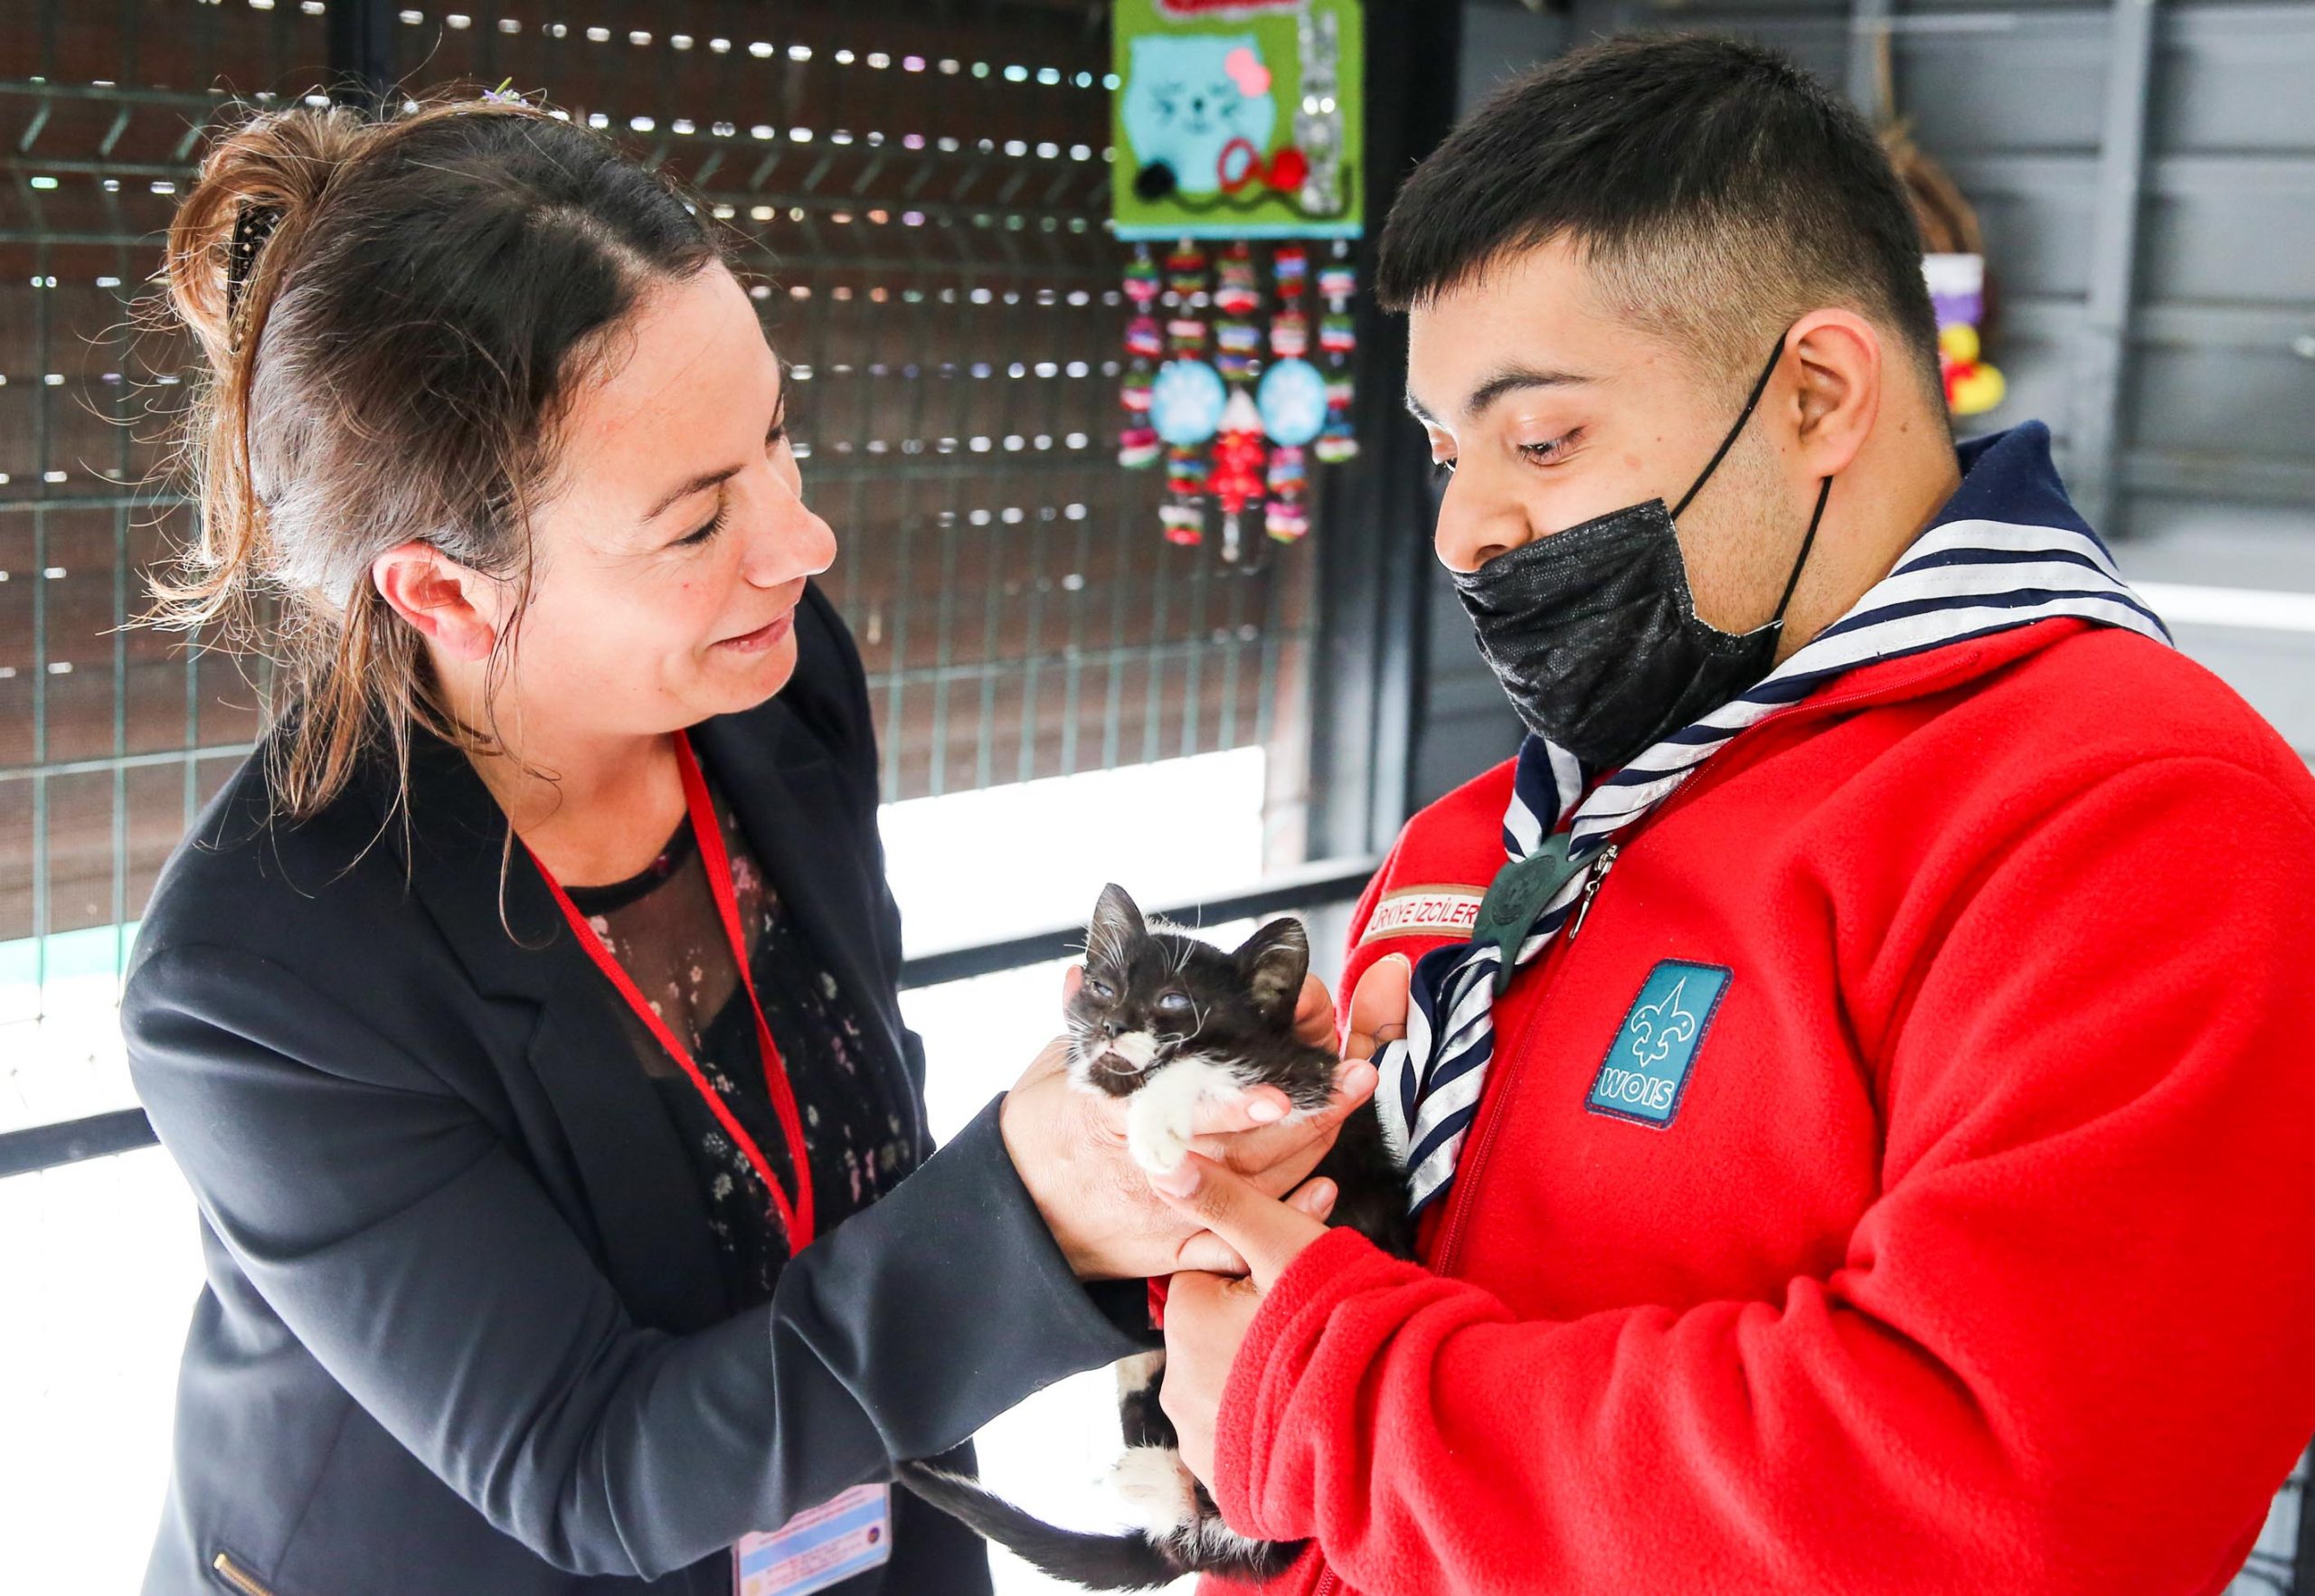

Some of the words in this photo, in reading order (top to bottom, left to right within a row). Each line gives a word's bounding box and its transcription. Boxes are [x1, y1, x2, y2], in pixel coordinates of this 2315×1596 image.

[1370, 899, 1417, 931] ÜRKİYE
[1413, 896, 1482, 925] İZCİLER
[1600, 1067, 1676, 1110] WOIS
